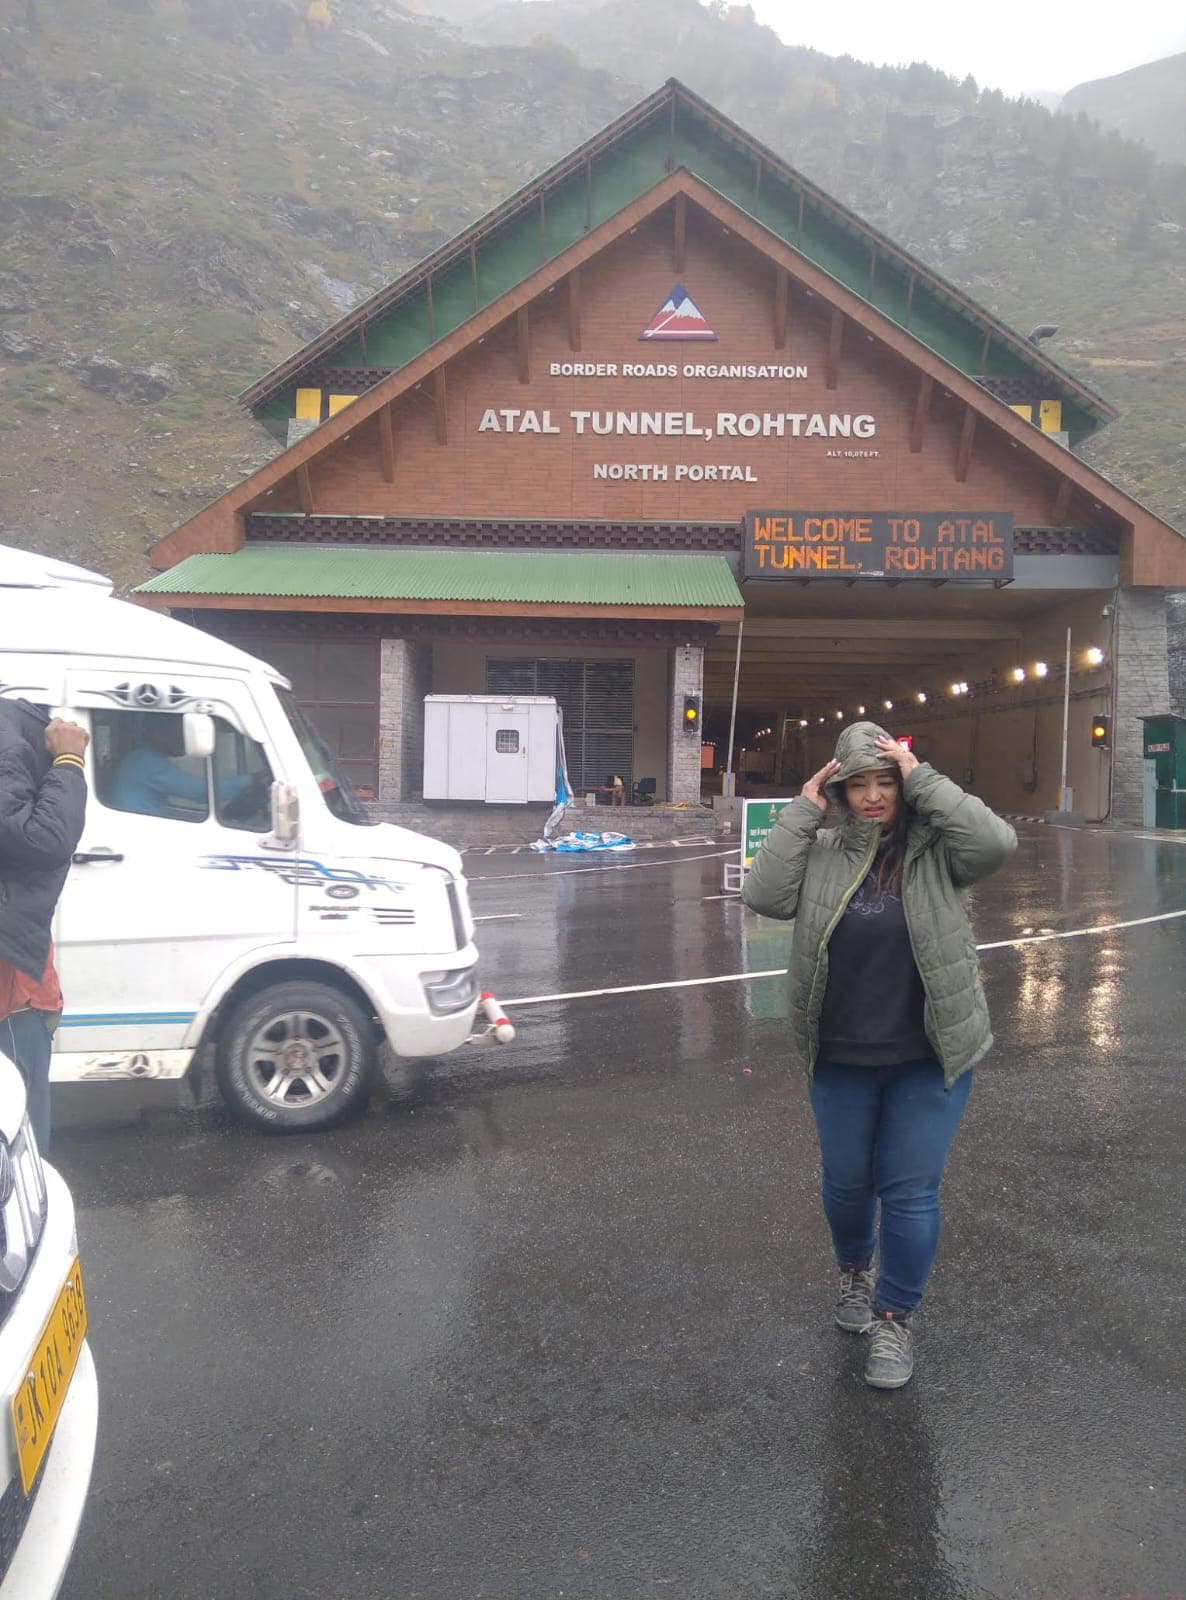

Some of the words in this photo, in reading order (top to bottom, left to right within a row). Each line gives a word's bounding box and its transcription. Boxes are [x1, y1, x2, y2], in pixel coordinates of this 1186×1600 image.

[549, 363, 617, 376] BORDER
[622, 364, 678, 377] ROADS
[683, 365, 808, 378] ORGANISATION
[478, 409, 561, 433] ATAL
[716, 413, 876, 438] ROHTANG
[593, 463, 668, 481] NORTH
[675, 464, 758, 482] PORTAL
[754, 517, 873, 542] WELCOME
[888, 518, 920, 542] TO
[937, 519, 1005, 543] ATAL
[754, 545, 863, 570] TUNNEL,
[885, 546, 1005, 571] ROHTANG
